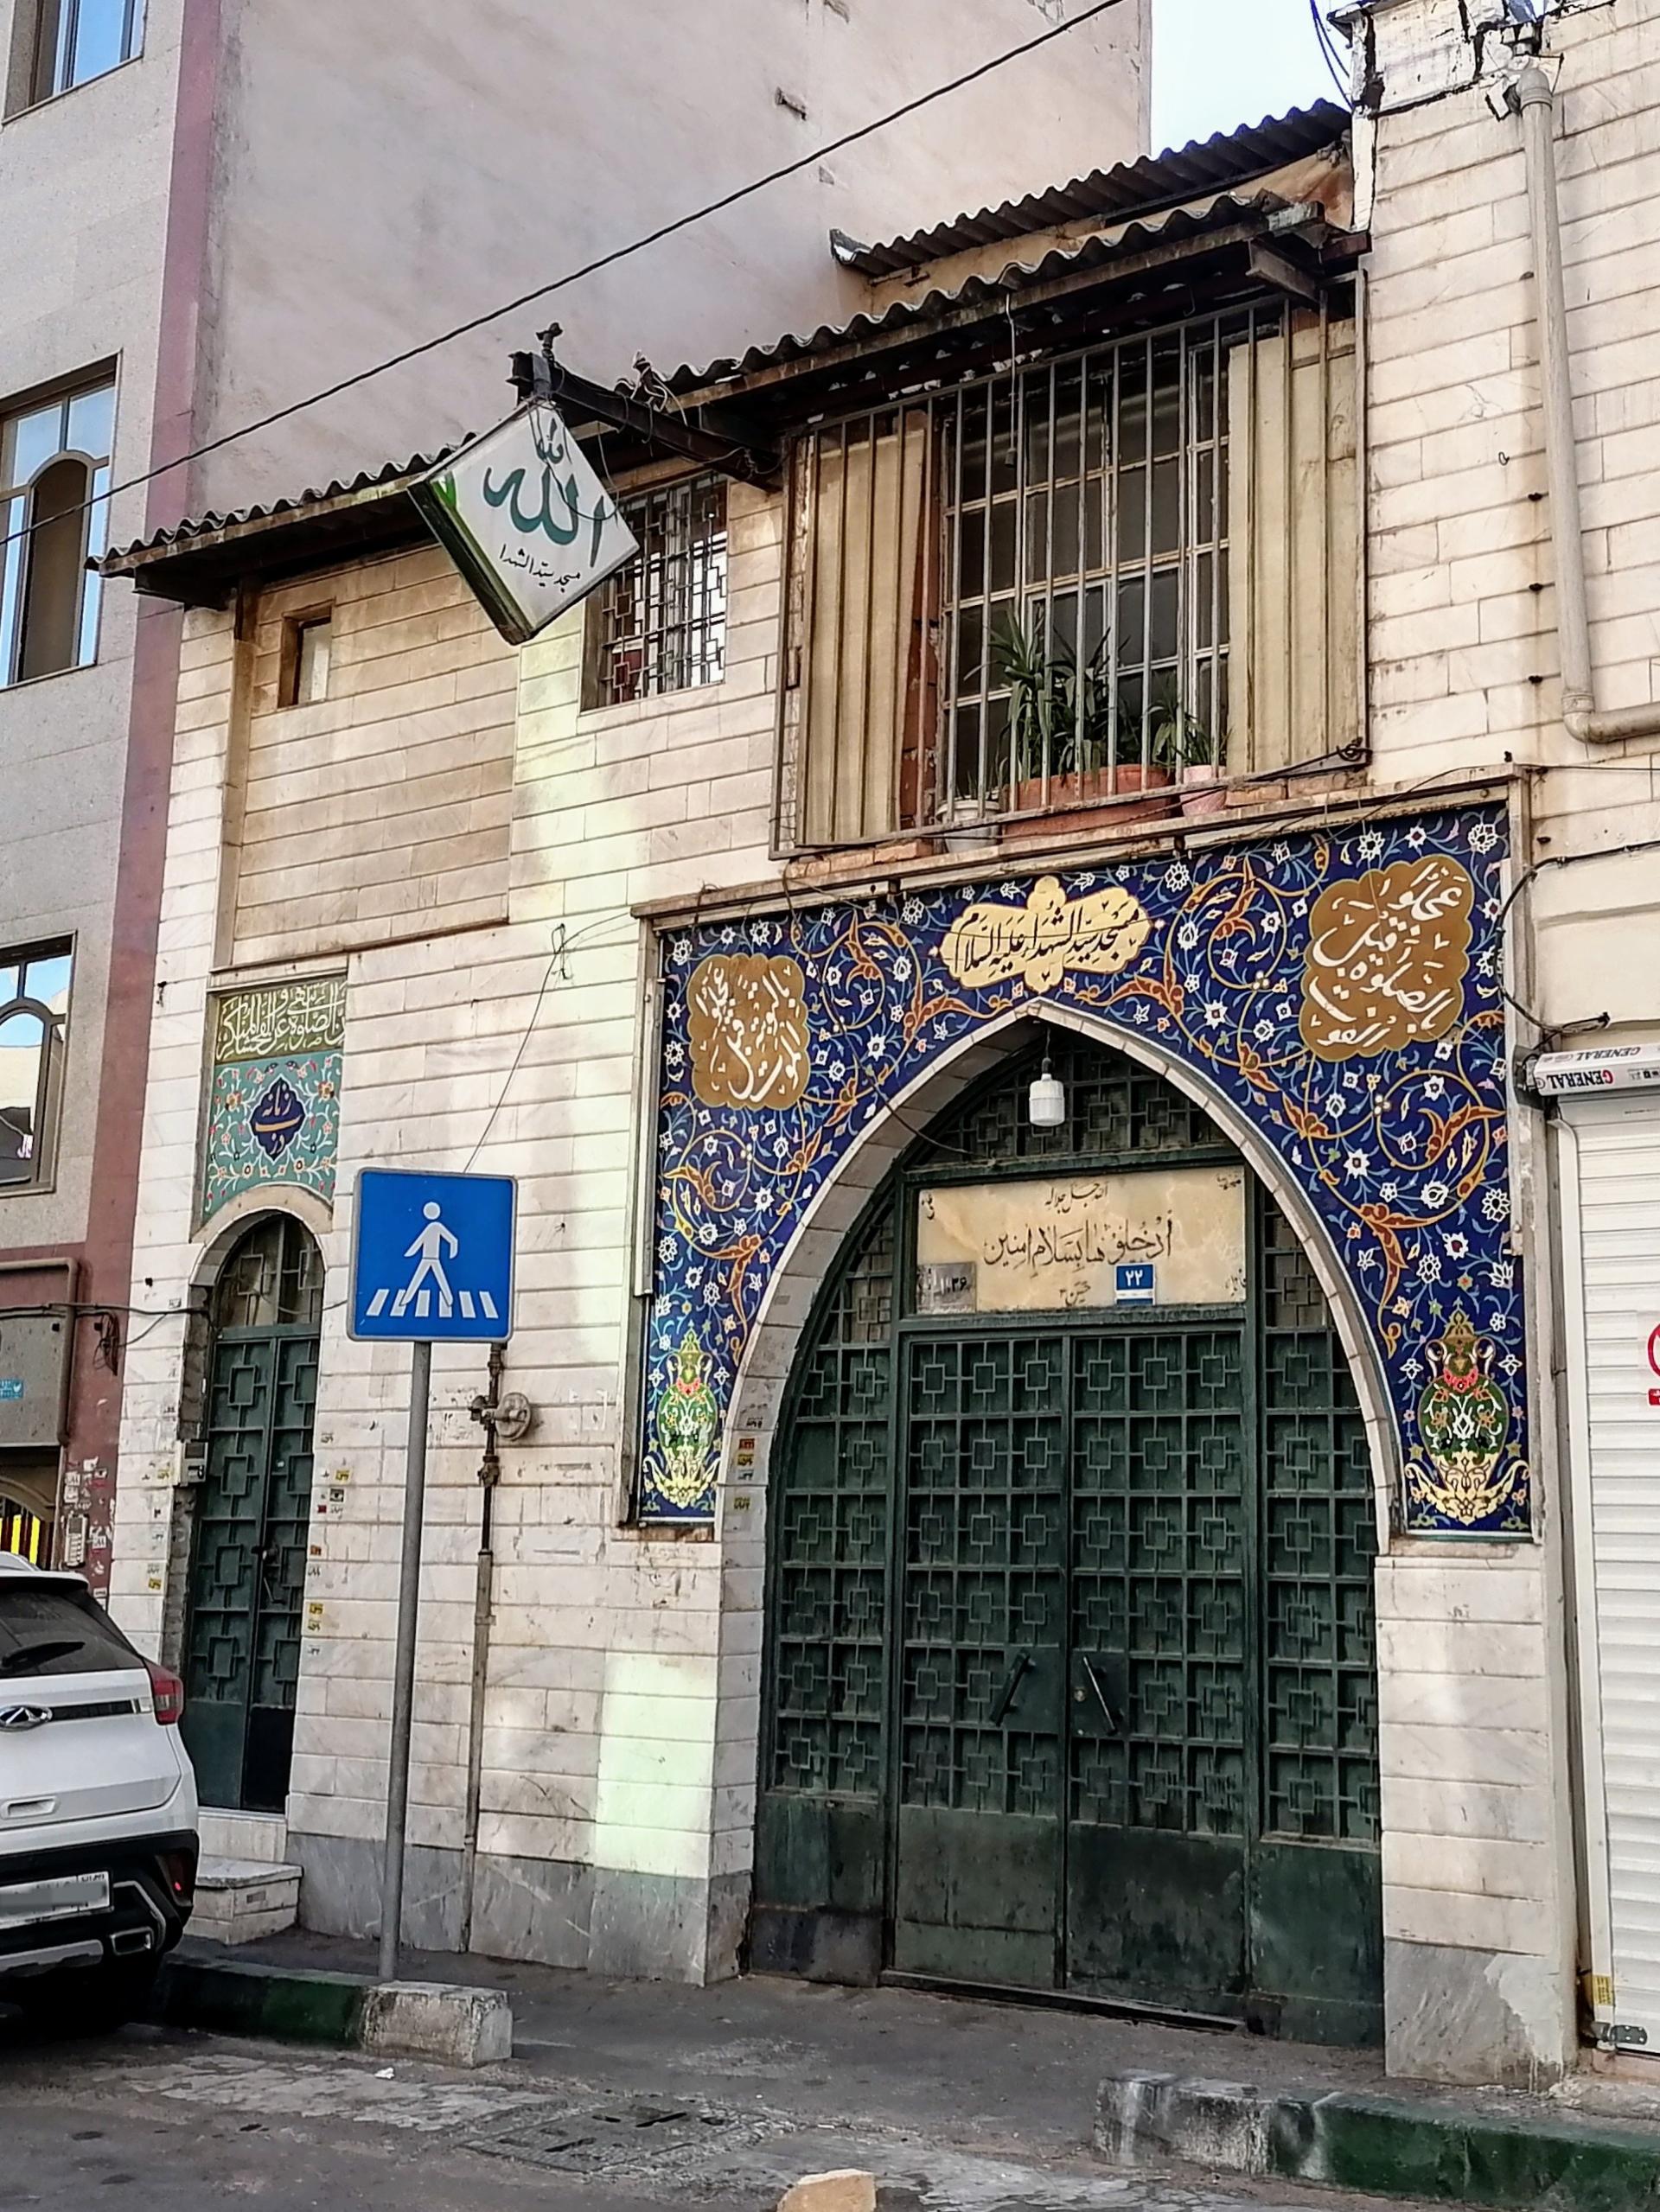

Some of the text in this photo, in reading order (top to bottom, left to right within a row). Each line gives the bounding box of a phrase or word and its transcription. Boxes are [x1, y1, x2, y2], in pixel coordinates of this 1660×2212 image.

[483, 418, 605, 568] الله
[553, 572, 581, 593] مسجد
[1090, 908, 1140, 961] مسجد
[1576, 1046, 1641, 1061] GENERAL
[1546, 1068, 1614, 1090] GENERAL
[1125, 1268, 1144, 1287] ۲۲
